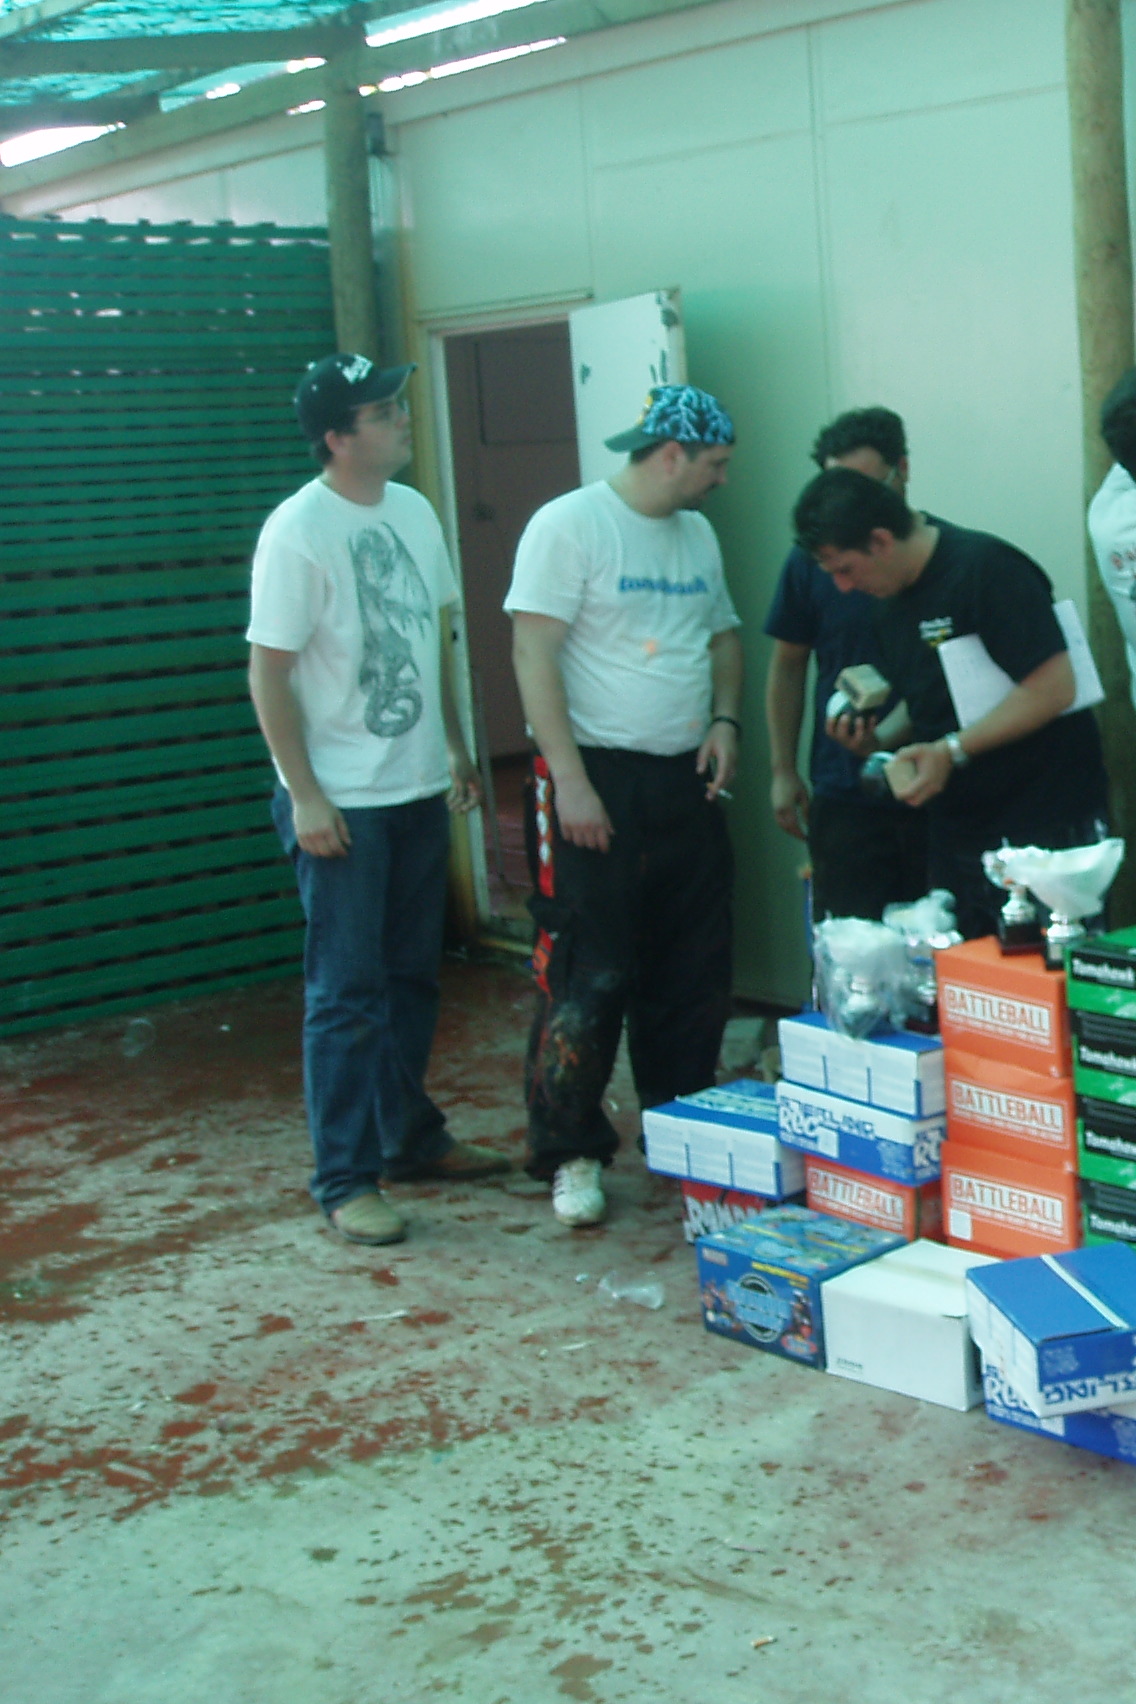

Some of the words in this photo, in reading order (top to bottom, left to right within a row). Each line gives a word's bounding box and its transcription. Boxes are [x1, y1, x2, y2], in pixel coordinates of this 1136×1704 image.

[945, 985, 1050, 1034] BATTLEBALL
[953, 1082, 1063, 1130] BATTLEBALL
[951, 1175, 1063, 1227] BATTLEBALL
